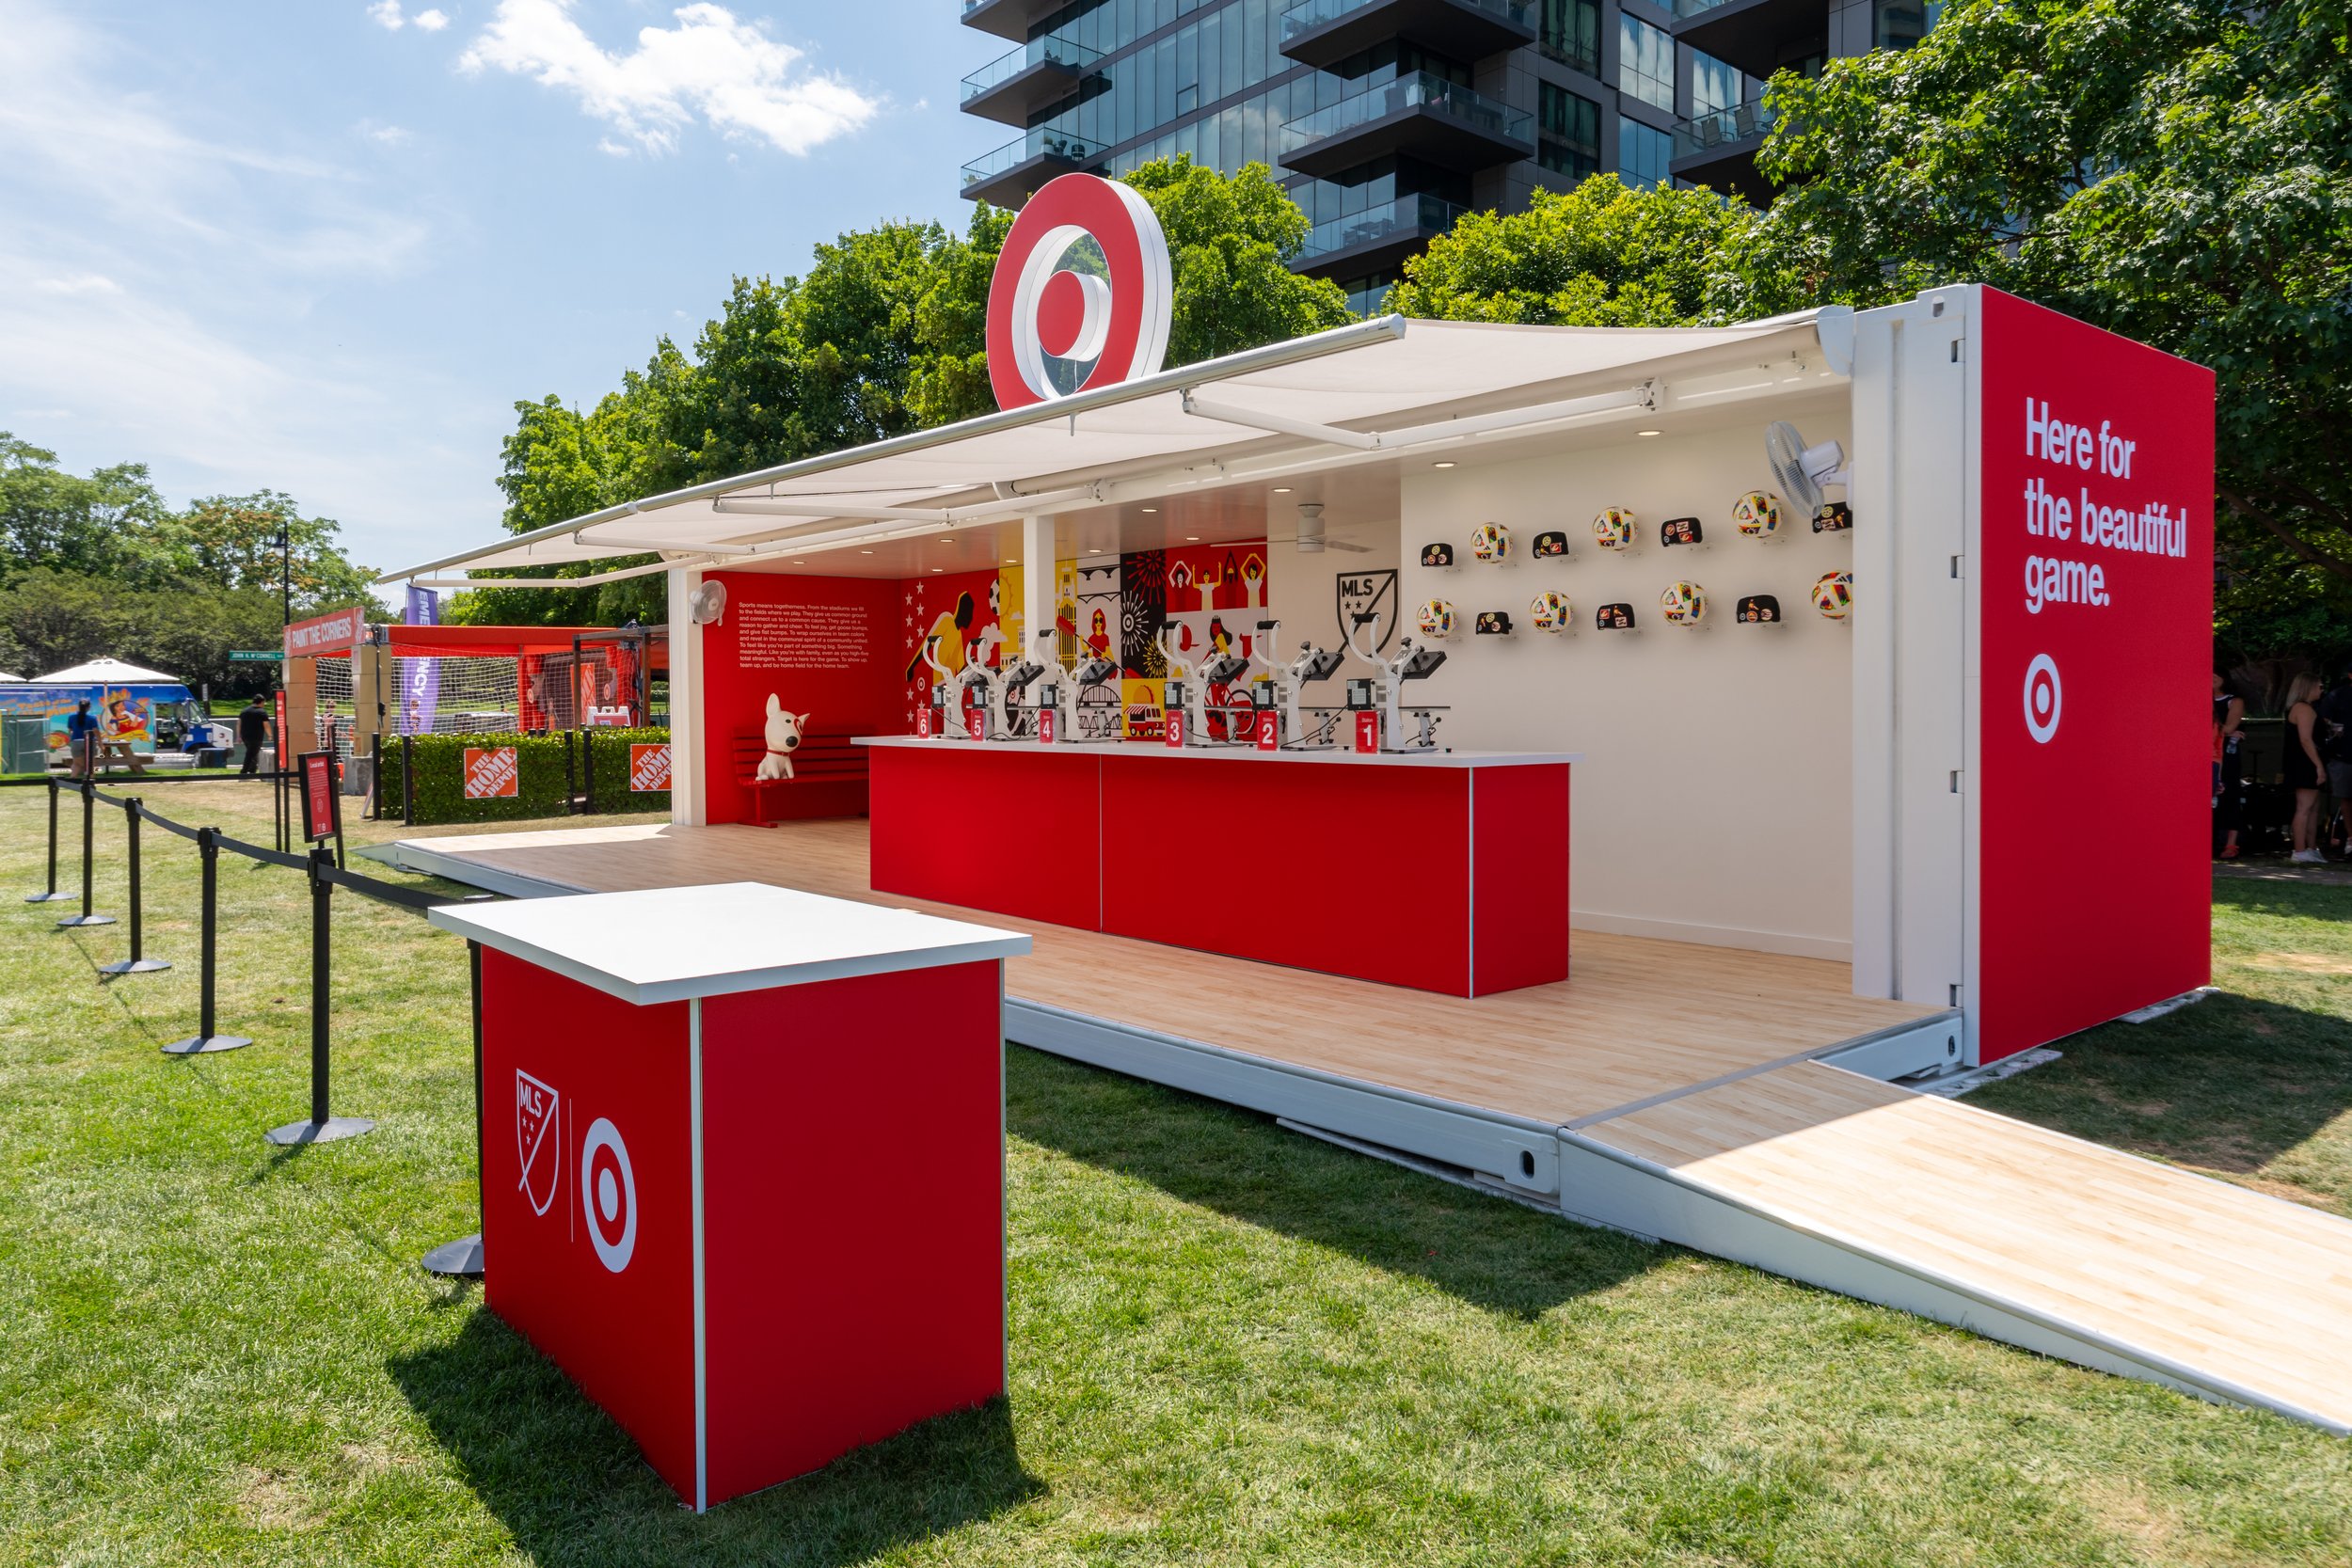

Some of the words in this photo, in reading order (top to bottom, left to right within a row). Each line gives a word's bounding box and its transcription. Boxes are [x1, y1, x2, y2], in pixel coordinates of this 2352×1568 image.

[2026, 396, 2094, 470] Here
[2098, 420, 2137, 480] for
[2024, 477, 2073, 541] the
[2080, 487, 2187, 558] beautiful
[1342, 578, 1374, 598] MLS
[2025, 555, 2110, 614] game.
[309, 625, 321, 645] THE
[321, 617, 352, 643] CORNERS
[920, 718, 927, 734] 6
[974, 719, 981, 736] 5
[1043, 721, 1051, 738] 4
[1170, 721, 1180, 742] 3
[1262, 723, 1273, 744] 2
[1363, 724, 1372, 747] 1
[469, 752, 492, 774] THE
[635, 749, 656, 768] THE
[466, 747, 517, 798] HOME
[485, 765, 517, 798] DEPOT
[519, 1081, 542, 1118] MLS
